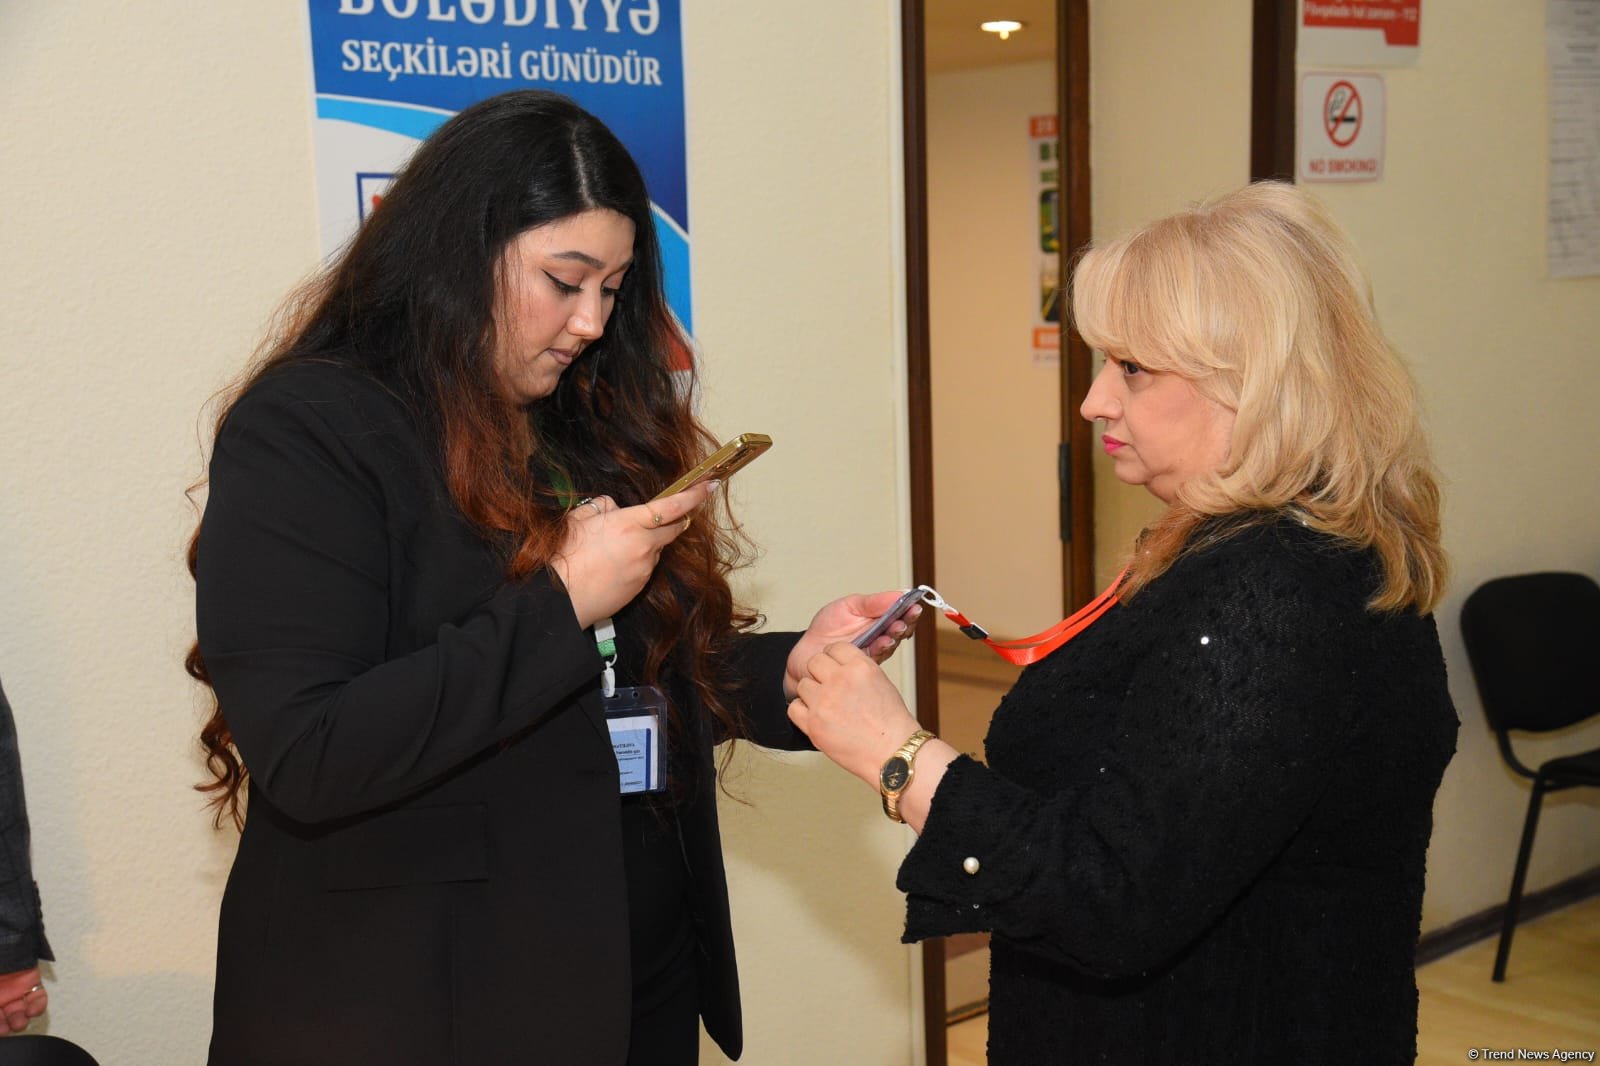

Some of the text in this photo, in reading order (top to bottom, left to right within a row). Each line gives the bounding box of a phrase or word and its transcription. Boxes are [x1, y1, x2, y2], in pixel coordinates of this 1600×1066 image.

[341, 37, 663, 86] SEÇKİLƏRİ GÜNÜDÜR
[1309, 158, 1326, 174] NO
